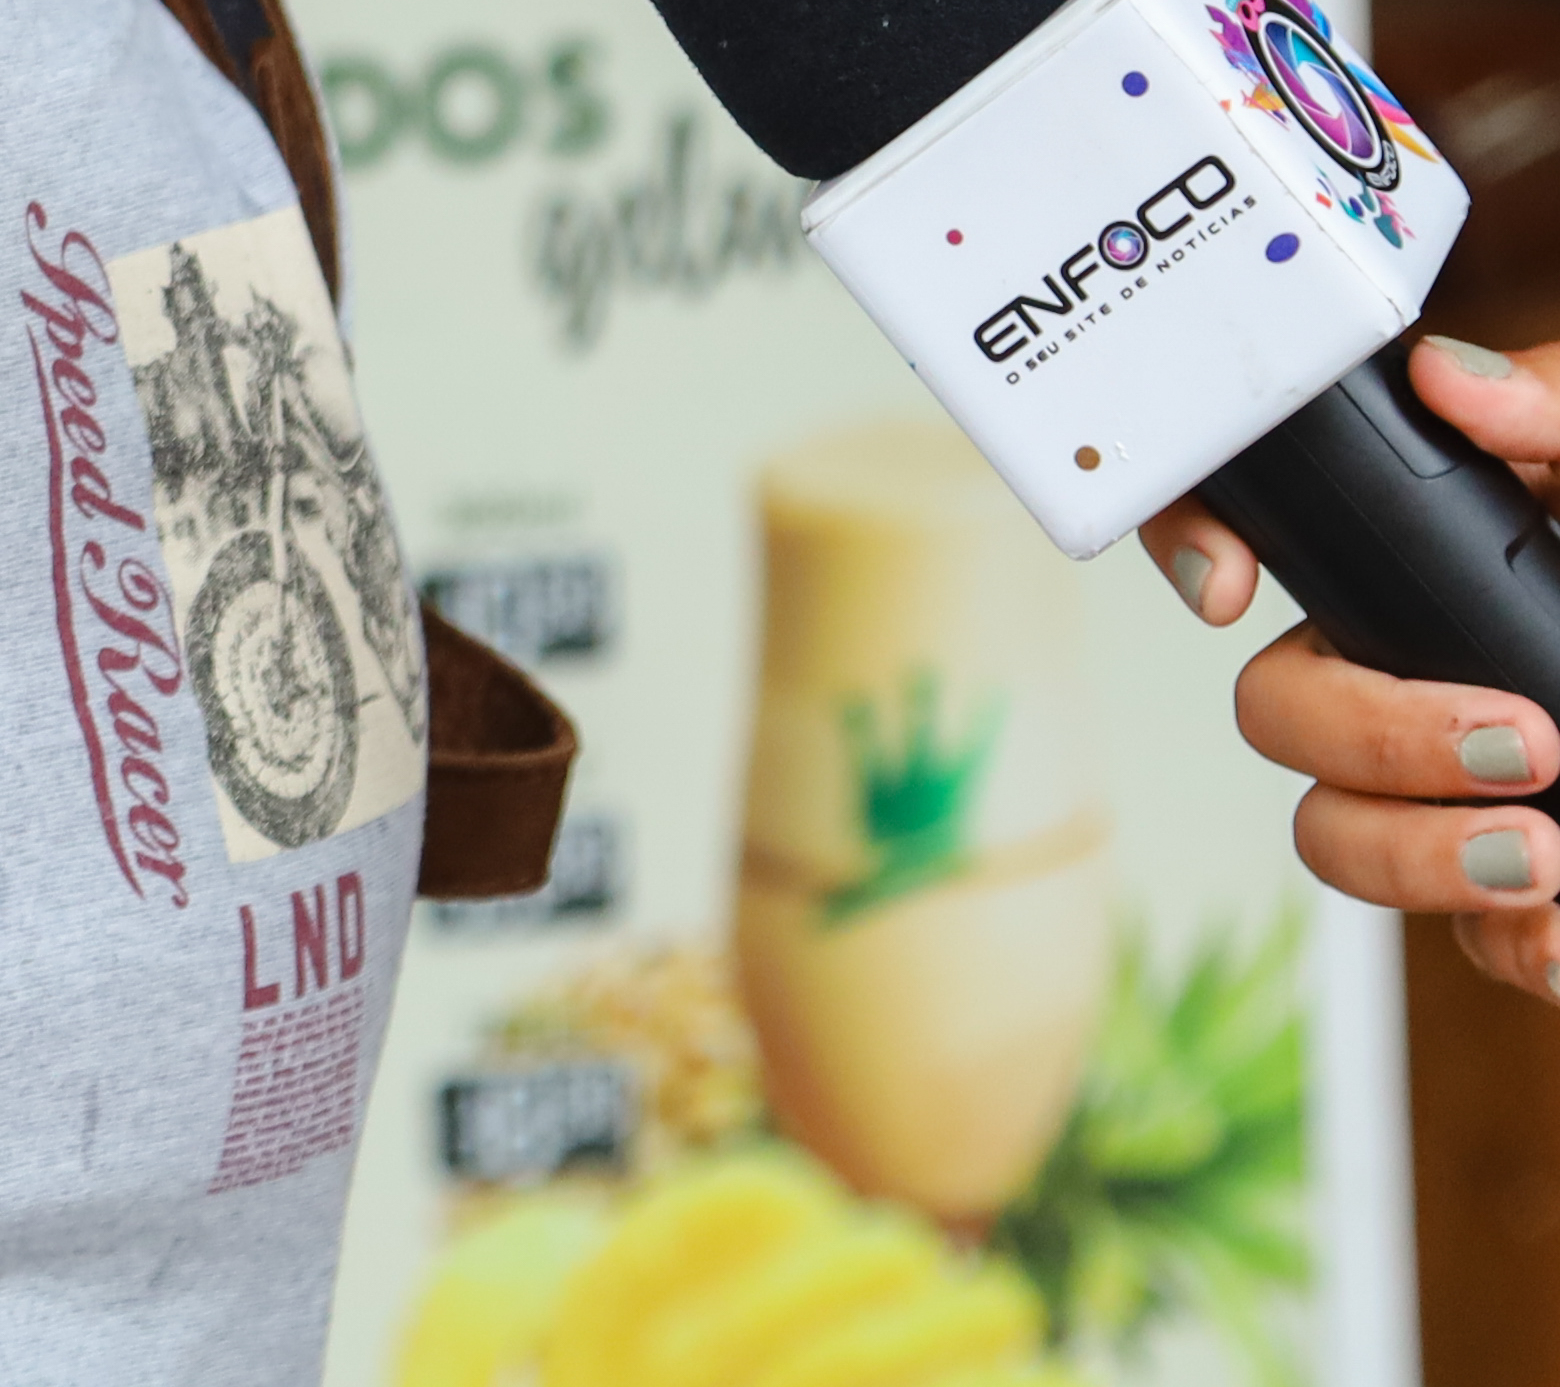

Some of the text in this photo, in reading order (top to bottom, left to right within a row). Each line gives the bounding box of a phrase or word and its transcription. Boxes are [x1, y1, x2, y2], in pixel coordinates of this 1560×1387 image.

[973, 154, 1237, 364] ENFOCO
[1005, 194, 1258, 386] O SEU SITE DE NOTÍCIAS
[19, 199, 189, 909] Speed Racer
[238, 871, 367, 1012] LND
